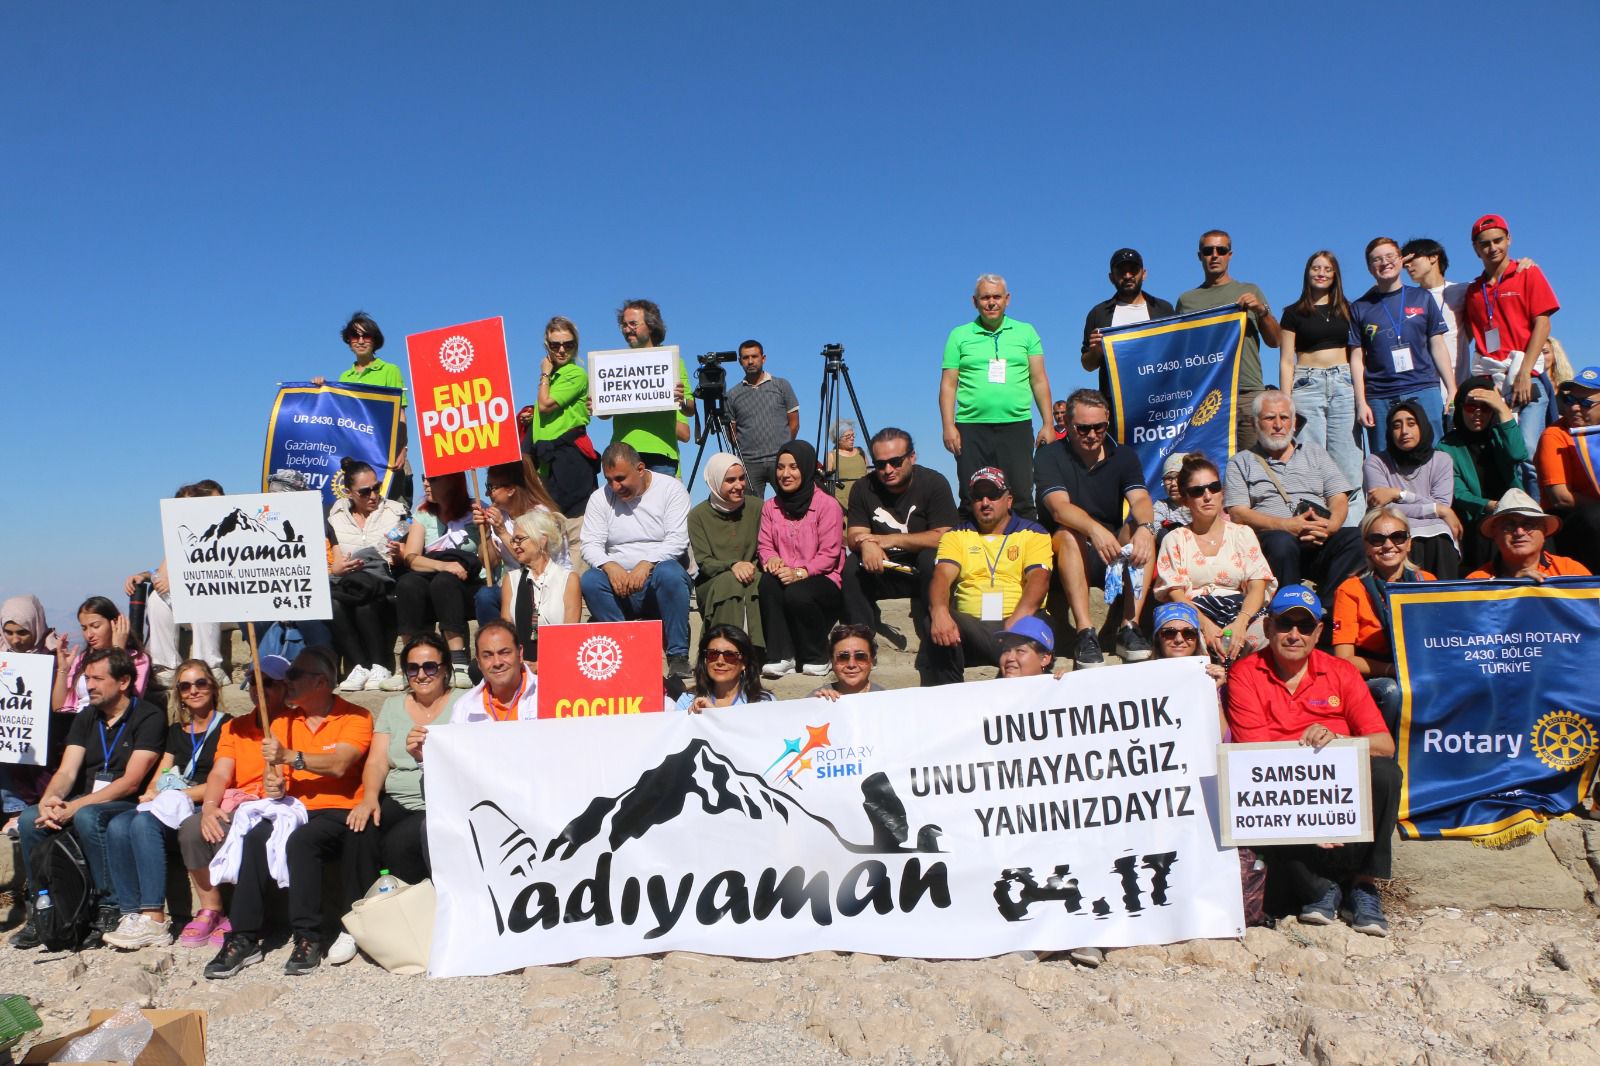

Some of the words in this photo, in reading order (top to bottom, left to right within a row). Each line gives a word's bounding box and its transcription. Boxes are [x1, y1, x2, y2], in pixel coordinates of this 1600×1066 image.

[598, 364, 669, 379] GAZİANTEP
[1137, 364, 1155, 376] UR
[1156, 360, 1182, 373] 2430.
[1185, 351, 1225, 368] BÖLGE
[603, 377, 665, 392] İPEKYOLU
[433, 377, 493, 411] END
[598, 393, 633, 403] ROTARY
[635, 389, 671, 401] KULÜBÜ
[1148, 388, 1193, 404] Gaziantep
[422, 397, 509, 437] POLIO
[1148, 405, 1194, 422] Zeugma
[293, 414, 309, 424] UR
[310, 415, 335, 426] 2430.
[337, 418, 375, 435] BÖLGE
[1133, 417, 1192, 444] Rotary
[284, 439, 337, 455] Gaziantep
[433, 421, 500, 458] NOW
[285, 453, 329, 468] İpekyolu
[190, 539, 307, 567] adıyaman
[238, 564, 312, 580] UNUTMAYACAĞIZ
[185, 579, 312, 597] YANINIZDAYIZ
[273, 595, 312, 609] 04.17
[1423, 633, 1523, 648] ULUSLARARASI
[1525, 631, 1581, 644] ROTARY
[1464, 649, 1498, 661] 2430.
[1501, 645, 1543, 660] BÖLGE
[1479, 660, 1532, 674] TÜRKİYE
[983, 695, 1182, 746] UNUTMADIK,
[1547, 717, 1577, 726] ROTARY
[1424, 728, 1523, 759] Rotary
[816, 746, 875, 763] ROTARY
[816, 762, 863, 779] SİHRİ
[910, 737, 1188, 797] UNUTMAYACAĞIZ,
[1251, 764, 1336, 783] SAMSUN
[1237, 784, 1354, 808] KARADENİZ
[974, 785, 1195, 838] YANINIZDAYIZ
[1236, 813, 1292, 828] ROTARY
[1297, 809, 1356, 827] KULÜBÜ
[508, 851, 951, 940] adıyaman
